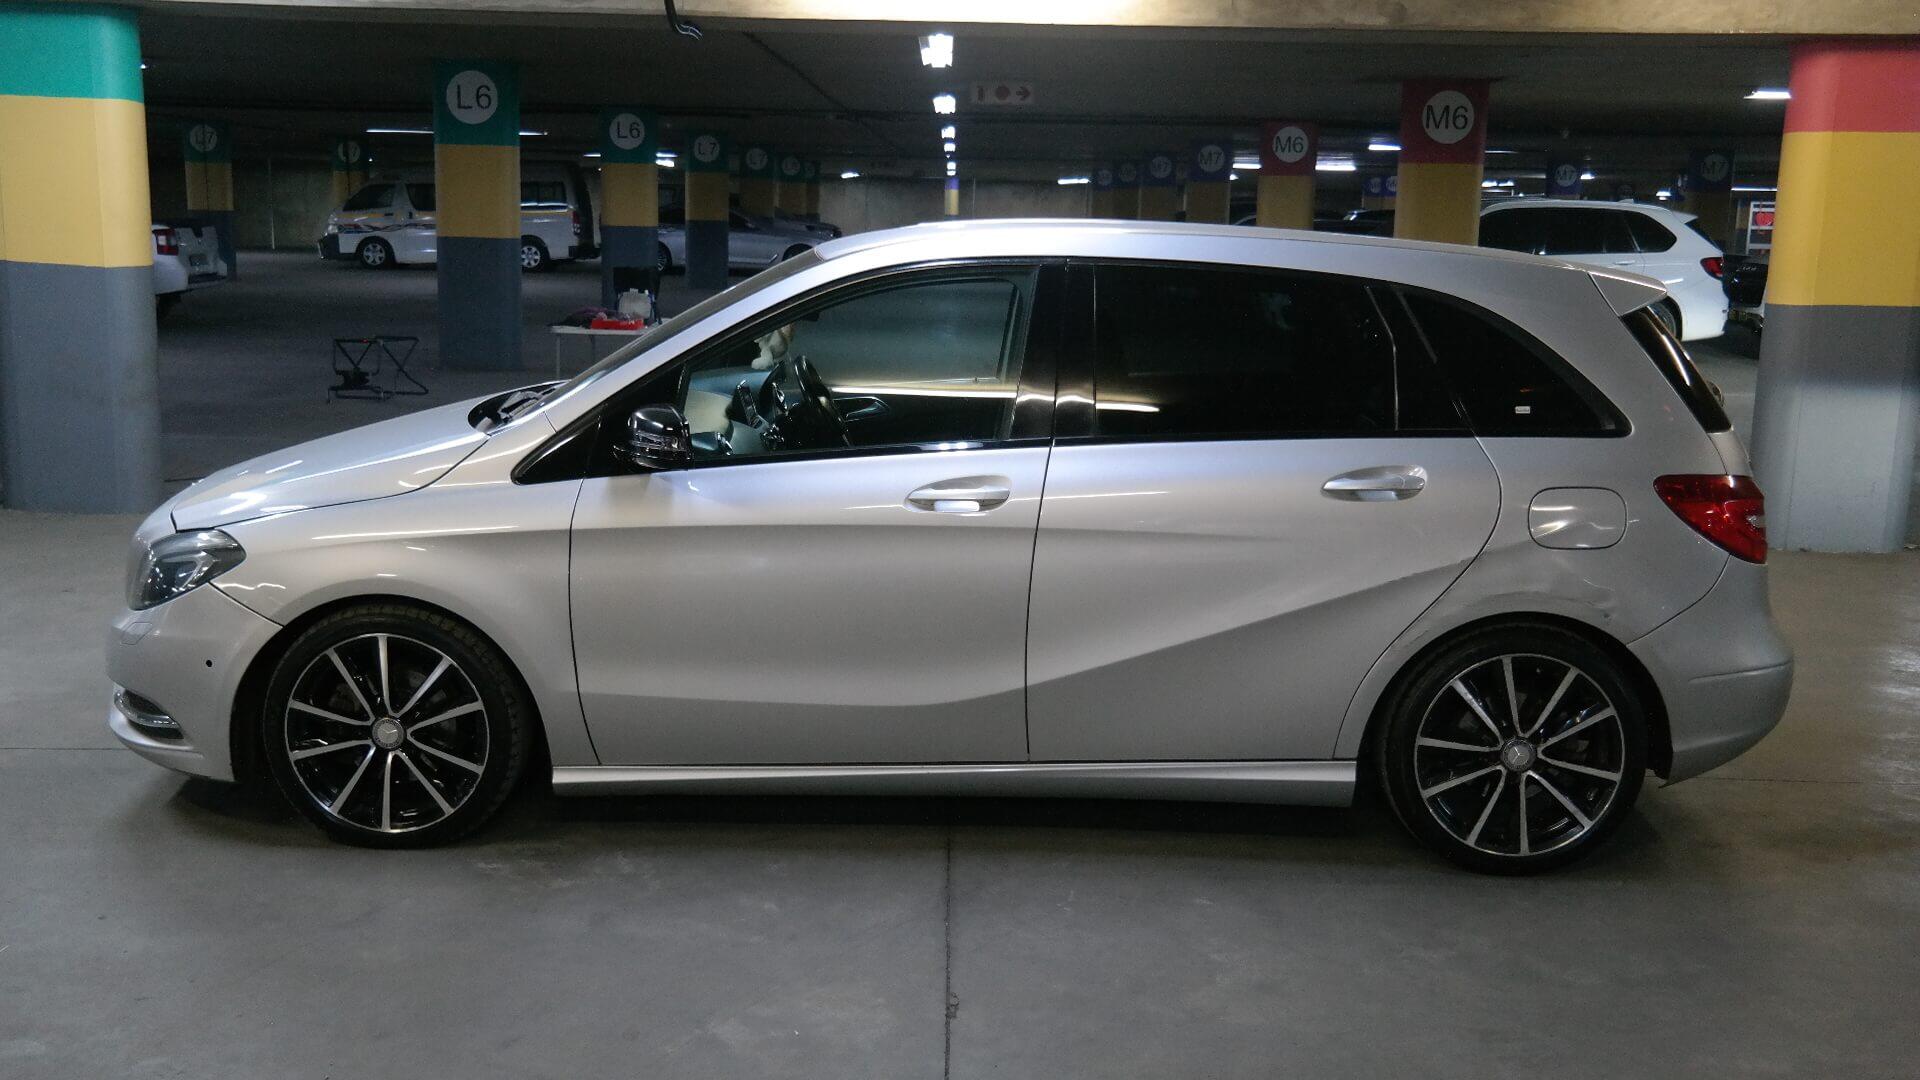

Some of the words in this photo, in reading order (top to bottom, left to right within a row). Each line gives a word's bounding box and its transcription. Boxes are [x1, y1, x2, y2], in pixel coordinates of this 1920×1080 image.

[457, 85, 491, 109] L6
[1425, 105, 1468, 129] M6
[617, 122, 640, 139] L6
[698, 142, 717, 156] L7
[1275, 136, 1304, 153] M6
